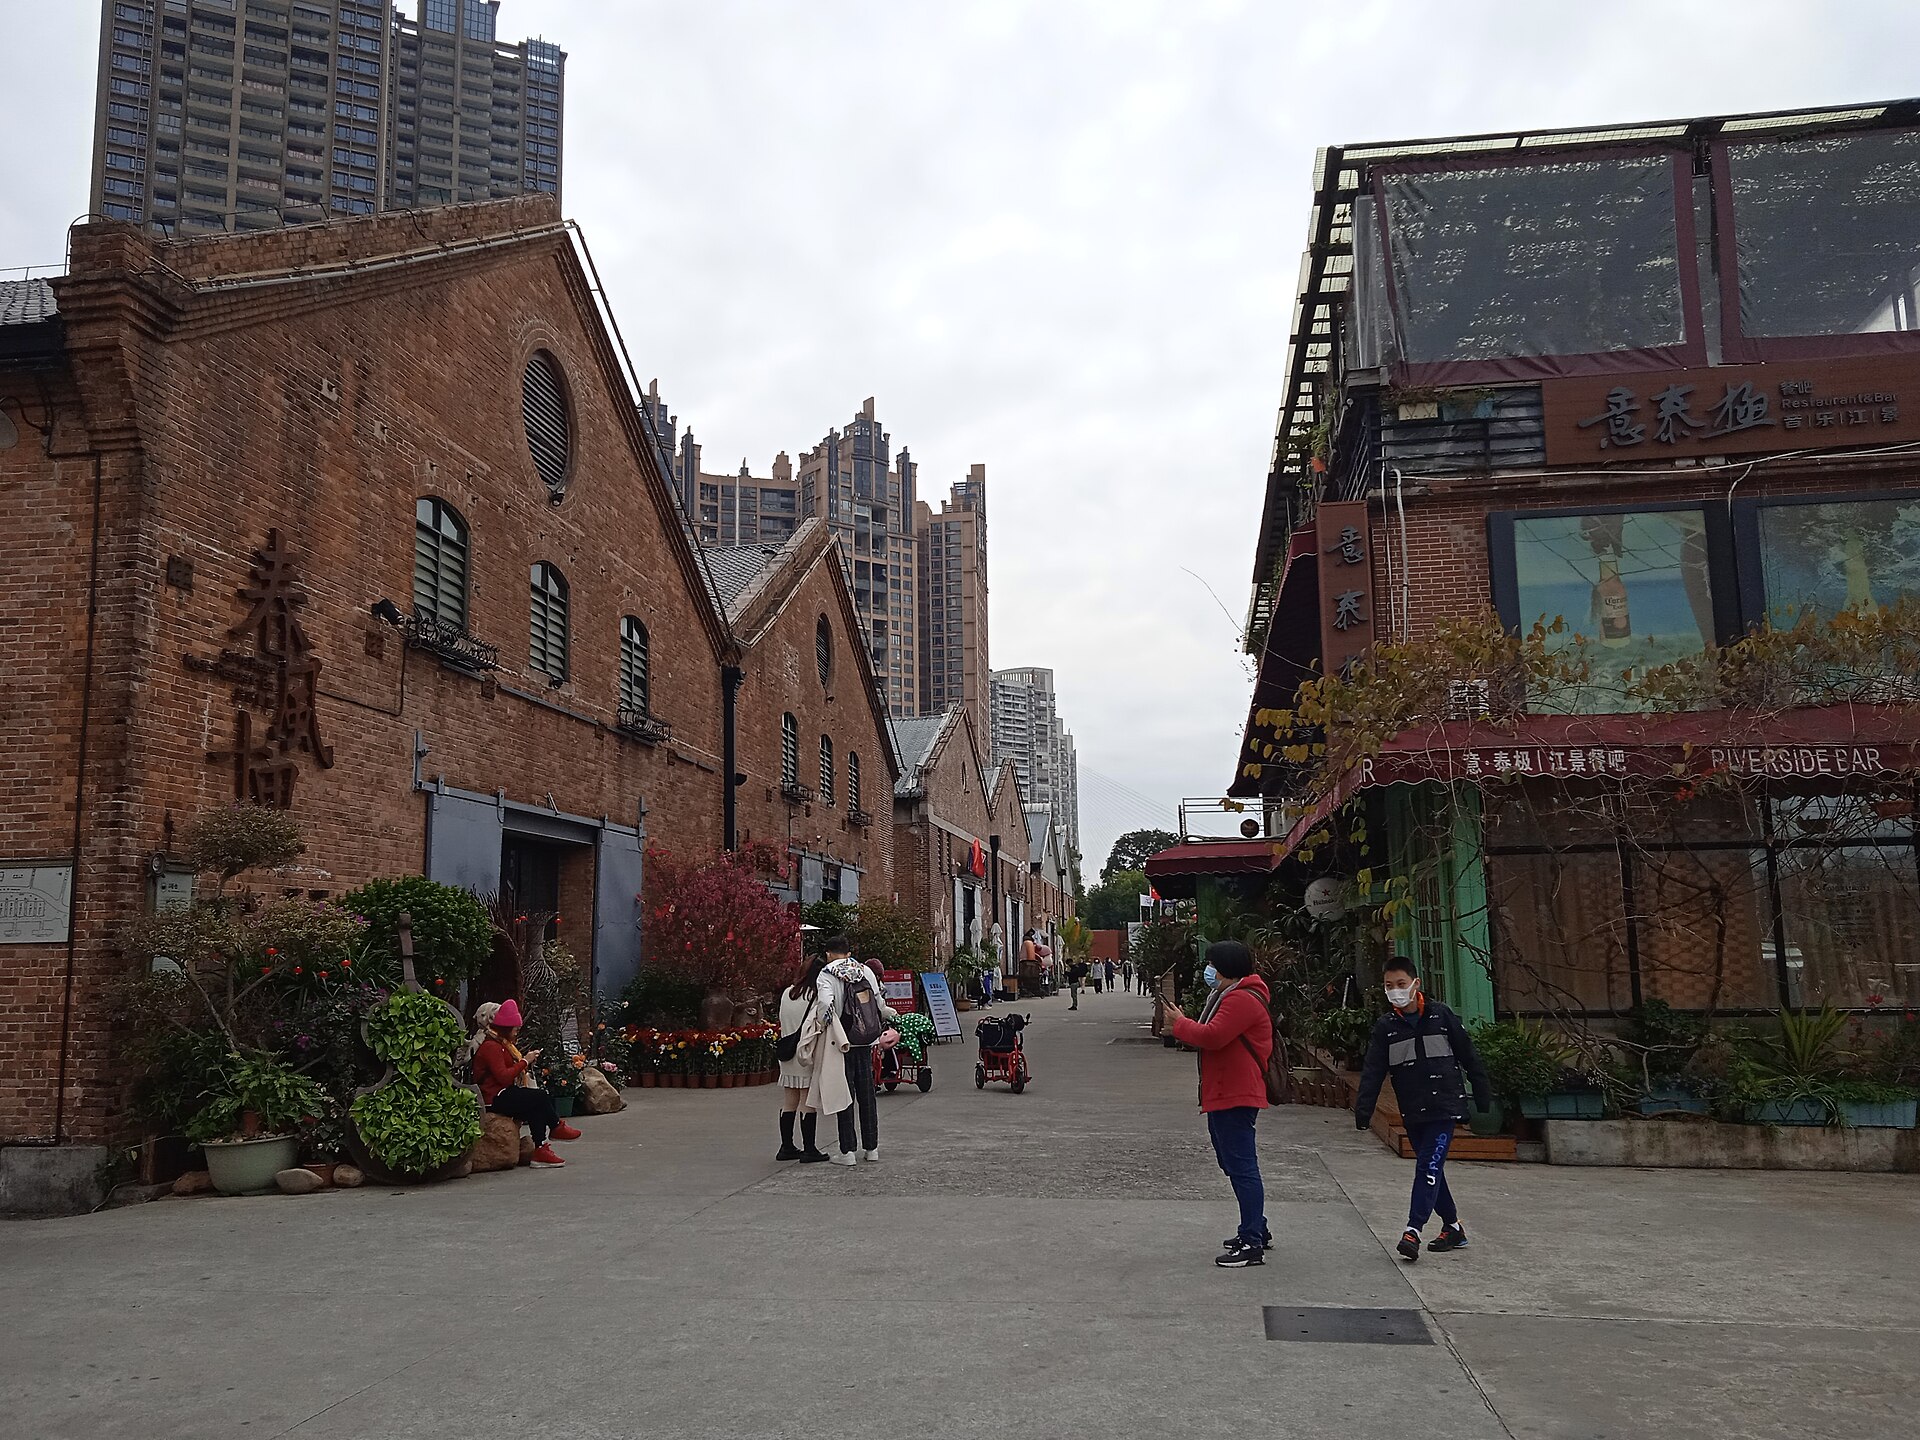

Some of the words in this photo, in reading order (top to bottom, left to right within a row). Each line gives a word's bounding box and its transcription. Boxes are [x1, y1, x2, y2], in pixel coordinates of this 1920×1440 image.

[1362, 757, 1375, 782] R
[1711, 748, 1831, 774] RIVERSIDE
[1835, 747, 1884, 773] BAR
